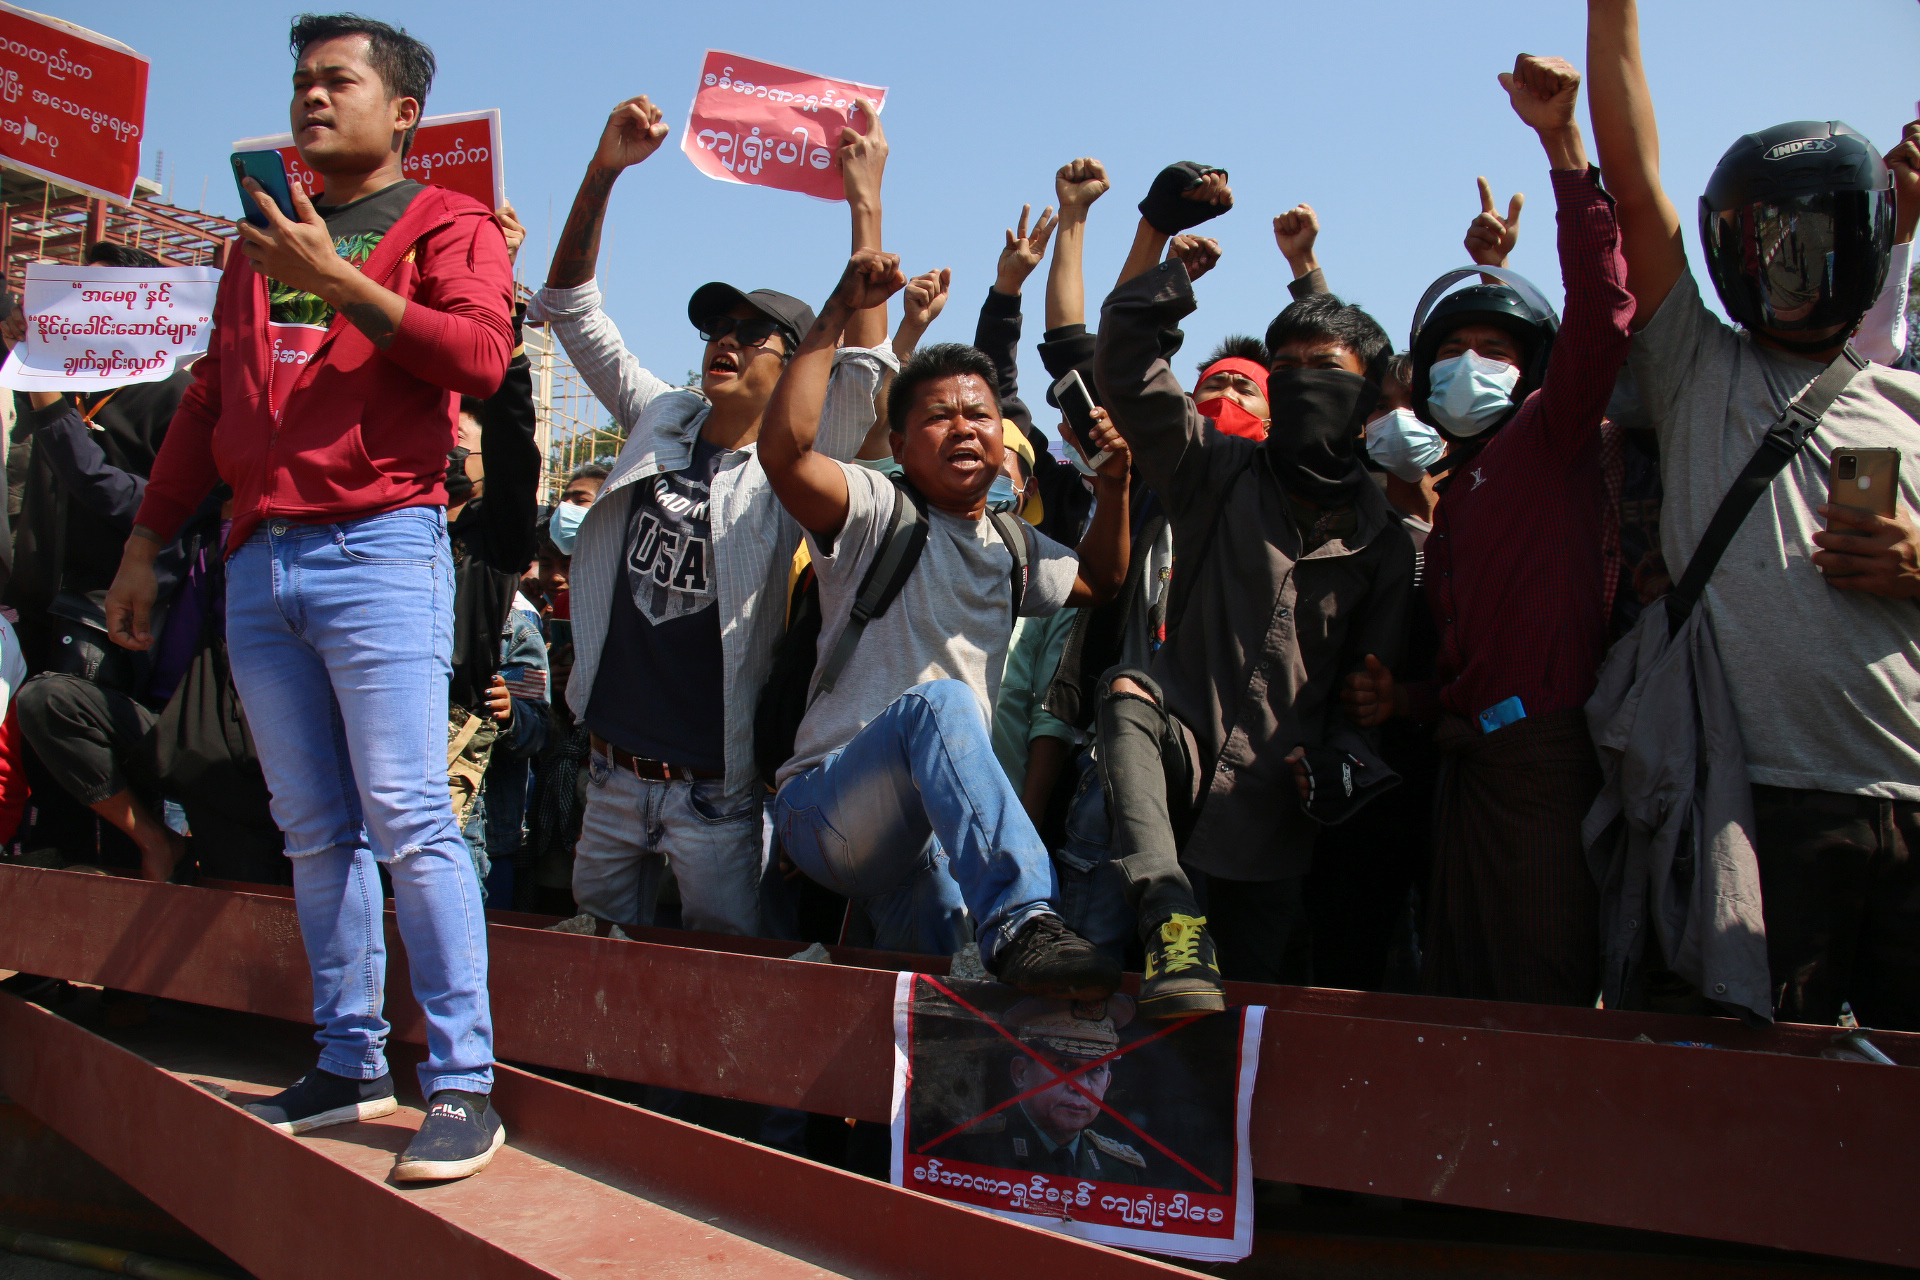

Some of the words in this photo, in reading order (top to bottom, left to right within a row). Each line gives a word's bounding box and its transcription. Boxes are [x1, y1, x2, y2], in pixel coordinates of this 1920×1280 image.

[1772, 140, 1827, 158] INDEX
[627, 511, 710, 594] USA
[432, 1103, 467, 1118] FILA
[913, 1159, 1097, 1213] စစ်အာဏာရှင်စနစ်
[1100, 1193, 1225, 1228] ကျရှုံးပါစေ
